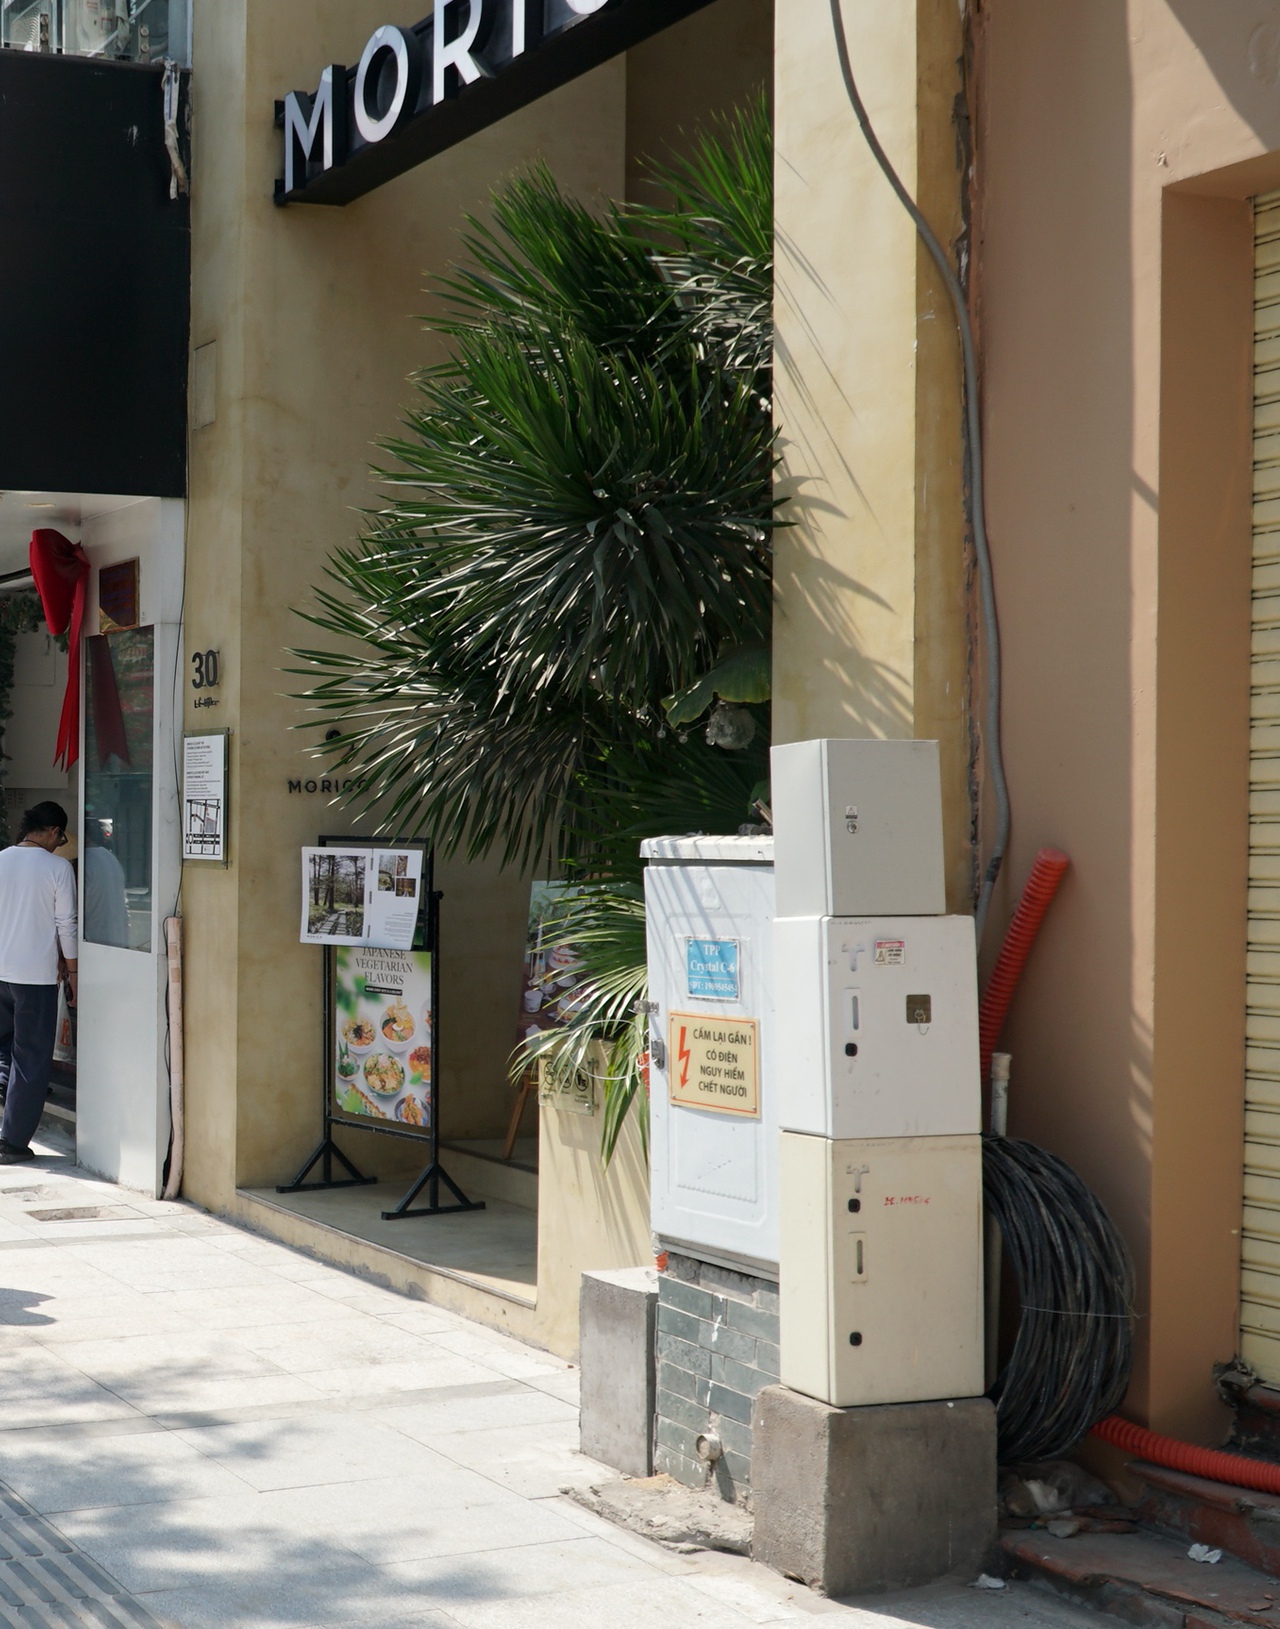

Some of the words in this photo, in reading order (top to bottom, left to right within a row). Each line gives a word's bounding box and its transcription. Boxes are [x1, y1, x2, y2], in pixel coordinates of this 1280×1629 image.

[191, 649, 218, 689] 30
[362, 947, 407, 960] JAPANESE
[702, 944, 721, 956] TPP
[355, 958, 414, 974] VEGETARIAN
[690, 959, 719, 974] Crystal
[720, 962, 736, 974] C-6
[364, 971, 405, 986] FLAVORS
[712, 1031, 727, 1046] LẠI
[705, 1048, 717, 1061] CÓ
[718, 1050, 738, 1066] ĐIỆN
[699, 1064, 723, 1078] NGUY
[698, 1079, 718, 1093] CHẾT
[719, 1083, 747, 1098] NGƯỜI
